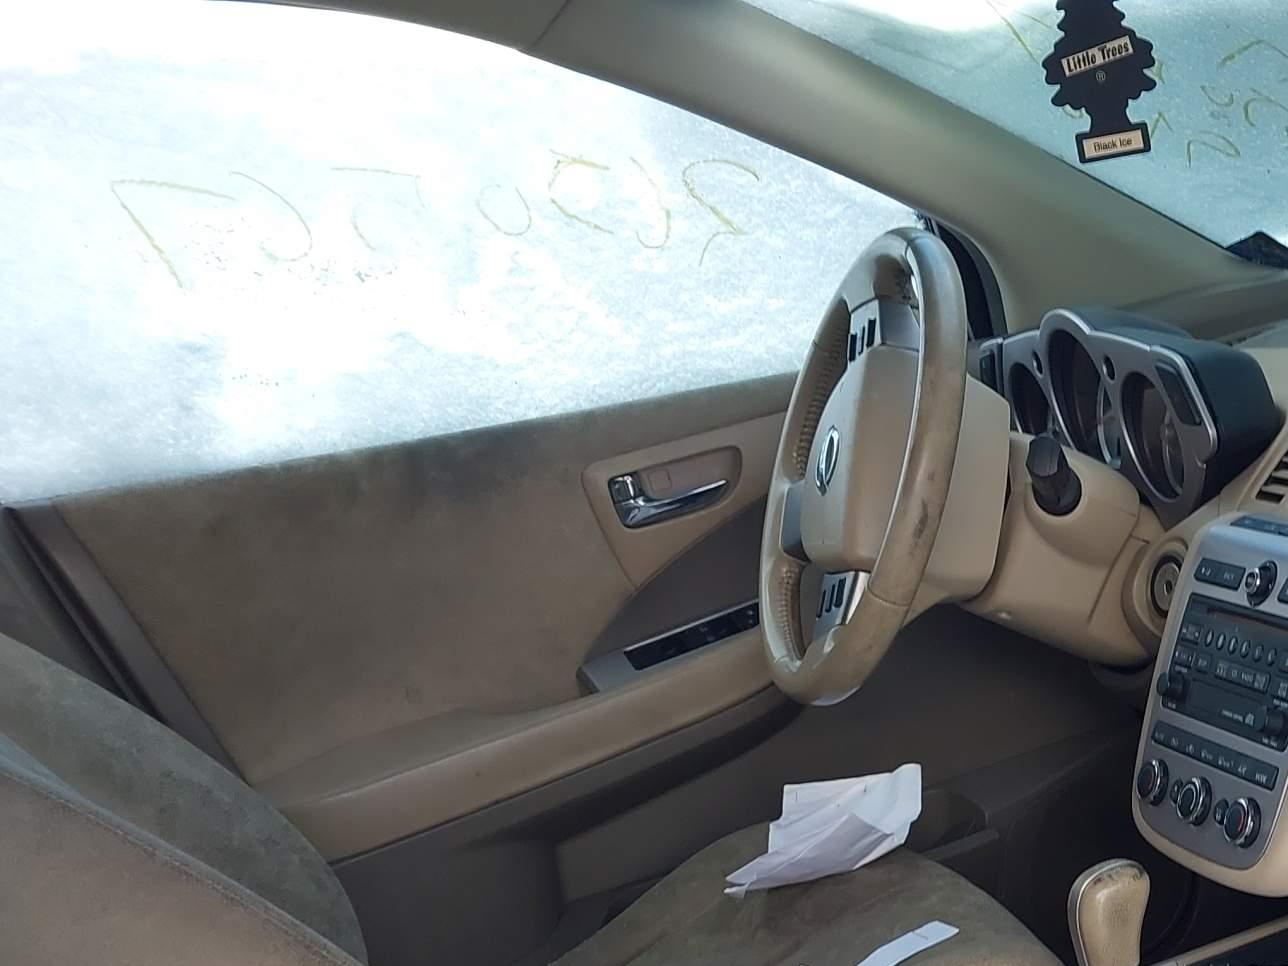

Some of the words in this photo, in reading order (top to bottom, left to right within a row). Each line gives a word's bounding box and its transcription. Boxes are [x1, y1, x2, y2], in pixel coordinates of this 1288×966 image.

[1066, 52, 1097, 73] Little
[1098, 40, 1130, 61] Trees
[1093, 140, 1117, 153] Black
[1119, 137, 1133, 147] Ice
